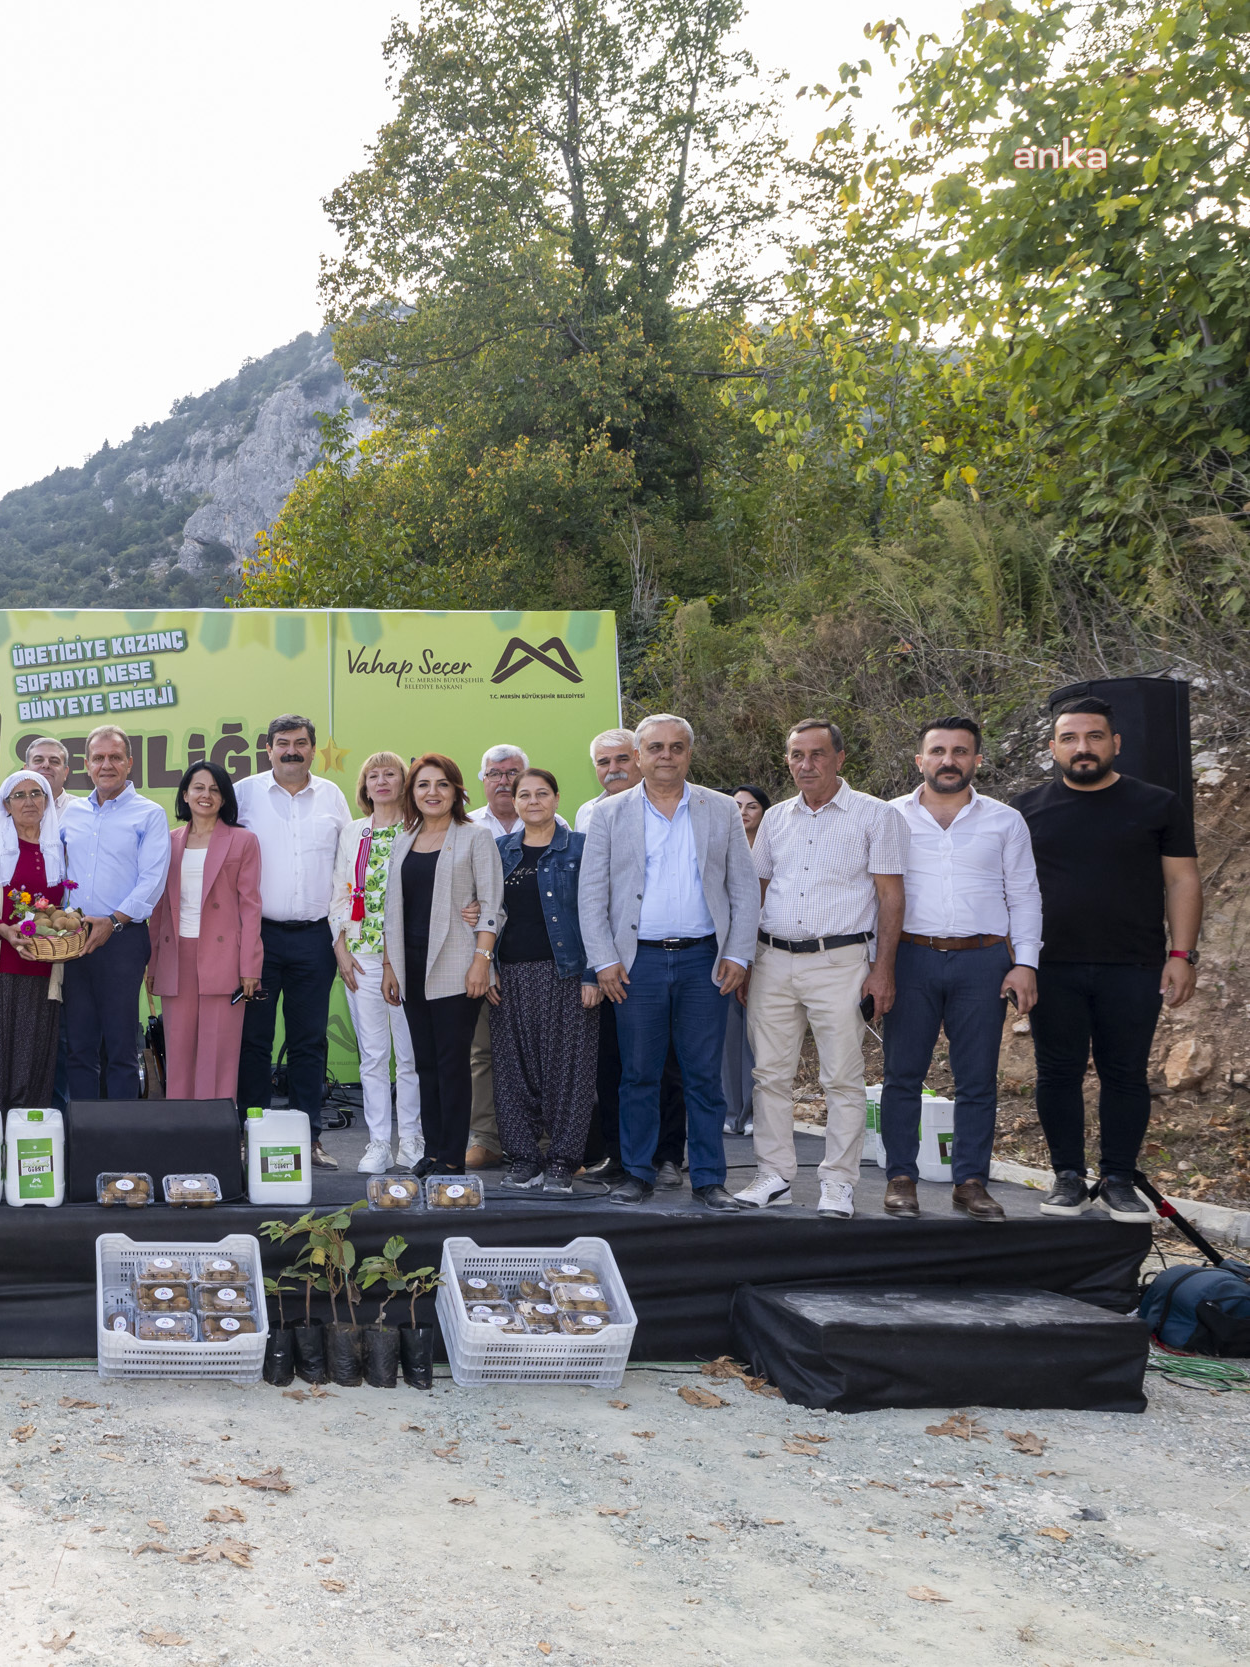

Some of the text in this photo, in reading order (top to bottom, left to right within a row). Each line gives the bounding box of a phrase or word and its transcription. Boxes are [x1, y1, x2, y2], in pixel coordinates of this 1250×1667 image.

[12, 630, 184, 667] ÜRETİCİYE KAZANÇ
[347, 646, 472, 688] Vahap Seçer
[15, 661, 152, 693] SOFRAYA NEŞE
[18, 679, 174, 720] BÜNYEYE ENERJİ
